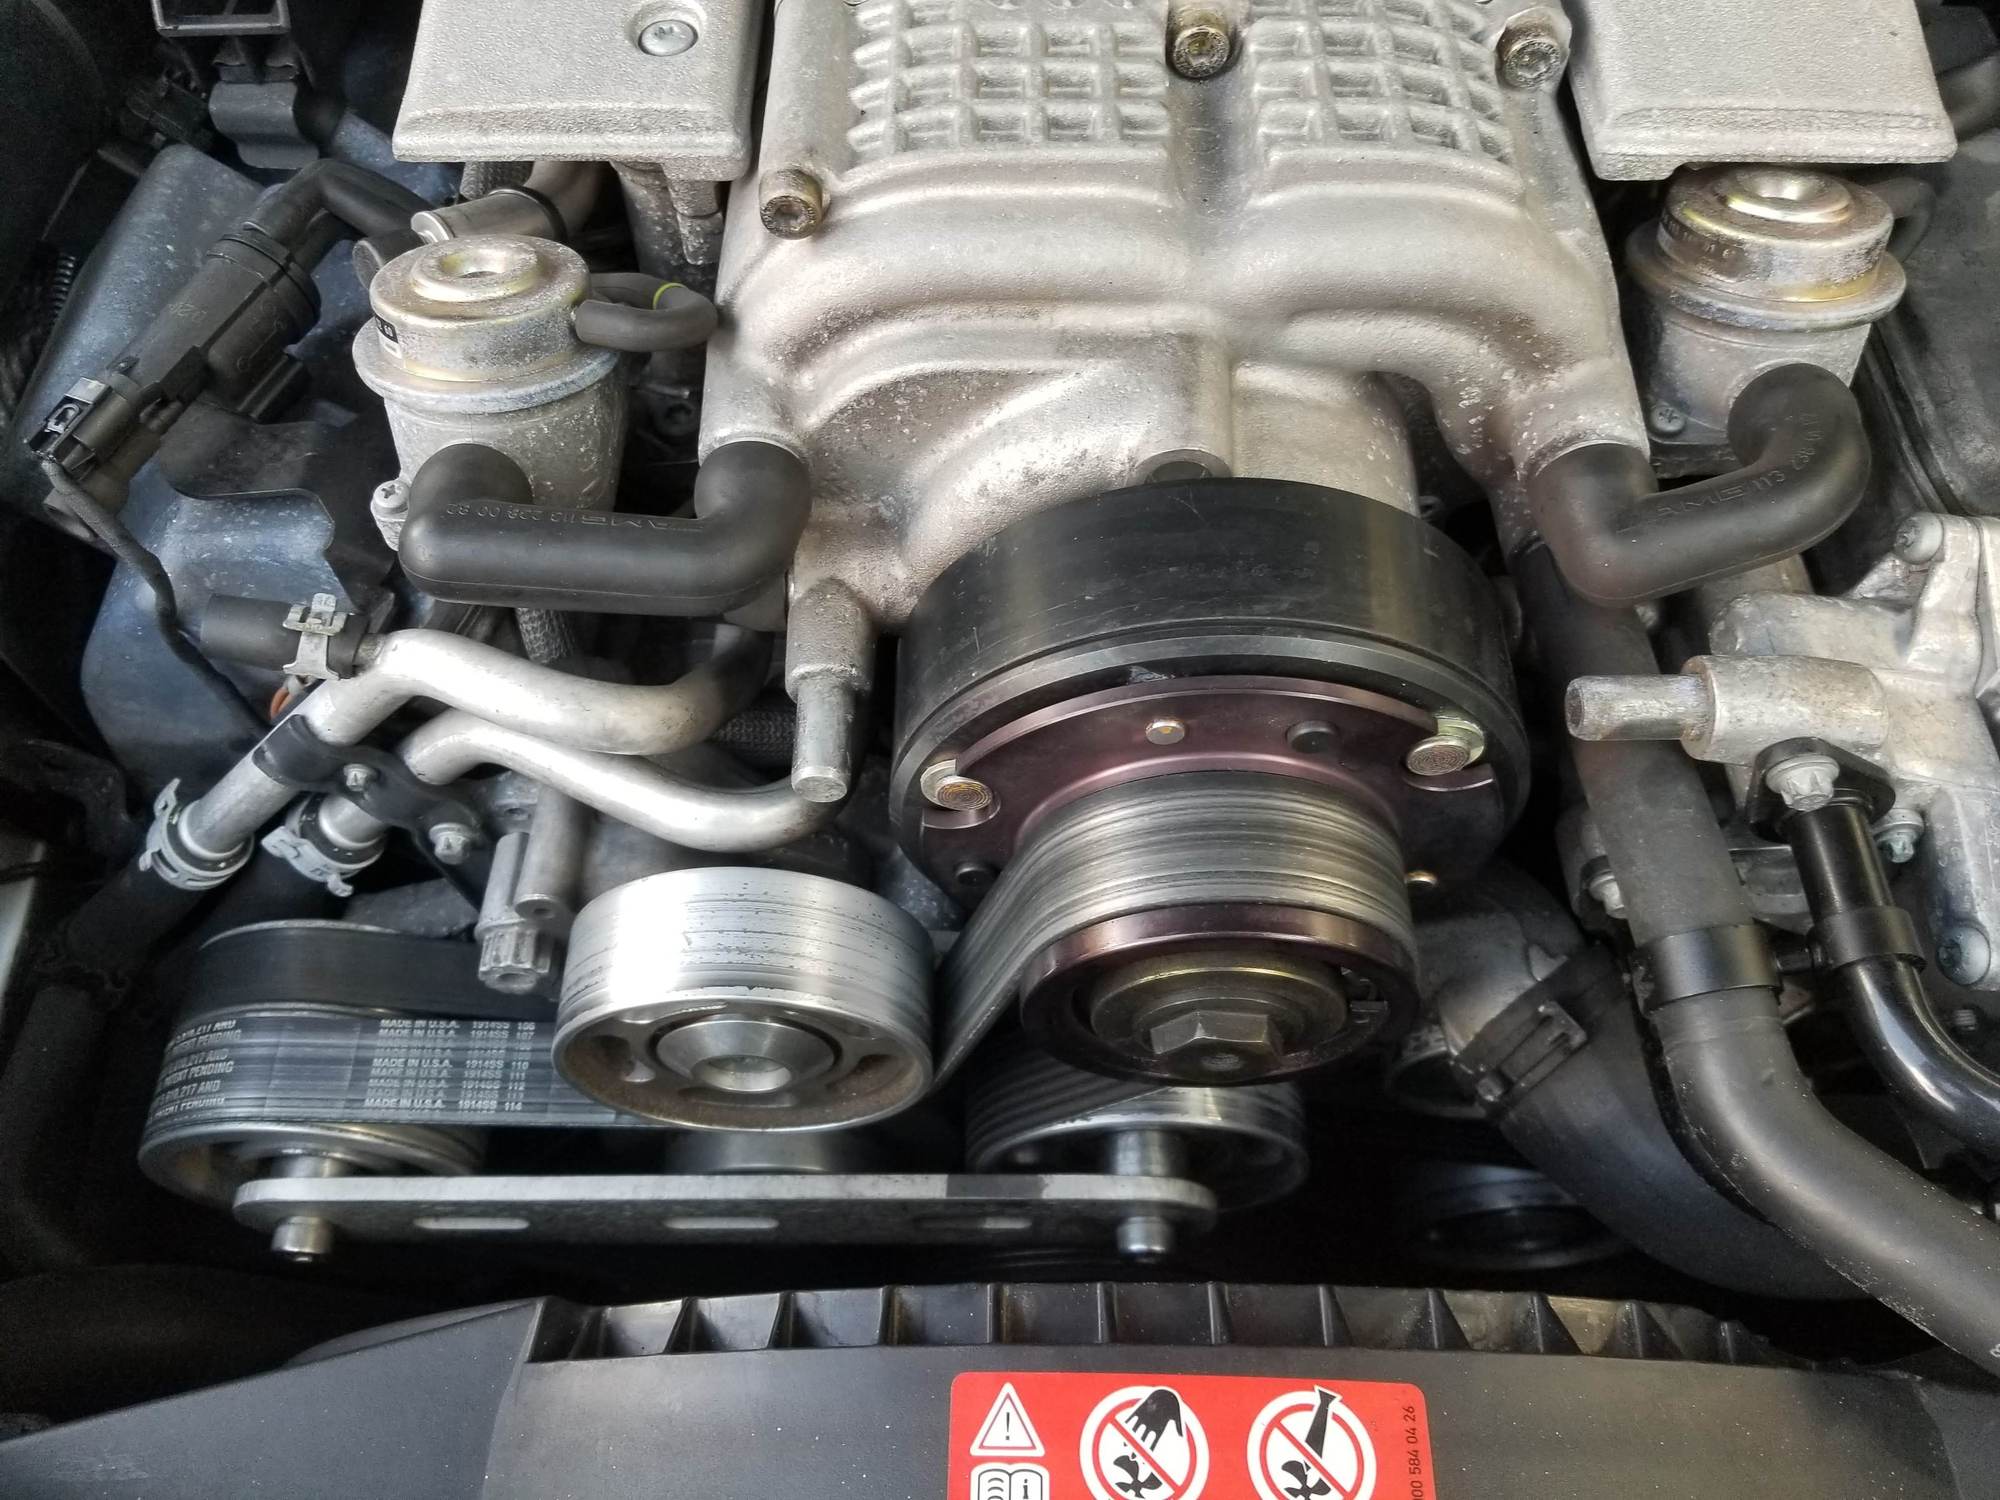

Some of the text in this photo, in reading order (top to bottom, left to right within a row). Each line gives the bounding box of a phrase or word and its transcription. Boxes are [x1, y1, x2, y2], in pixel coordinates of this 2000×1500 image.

[380, 1019, 411, 1028] MADE
[414, 1019, 427, 1028] IN
[378, 1029, 410, 1038] MADE
[413, 1029, 425, 1038] IN
[372, 1058, 405, 1067] MADE
[407, 1058, 419, 1067] IN
[511, 1061, 529, 1070] 110
[189, 1061, 234, 1079] PENDING
[370, 1068, 403, 1077] MADE
[405, 1068, 417, 1077] IN
[198, 1080, 220, 1093] AND
[368, 1078, 400, 1087] MADE
[403, 1078, 415, 1088] IN
[364, 1098, 397, 1108] MADE
[399, 1098, 412, 1108] IN
[1402, 1405, 1424, 1500] 00 584 04 26
